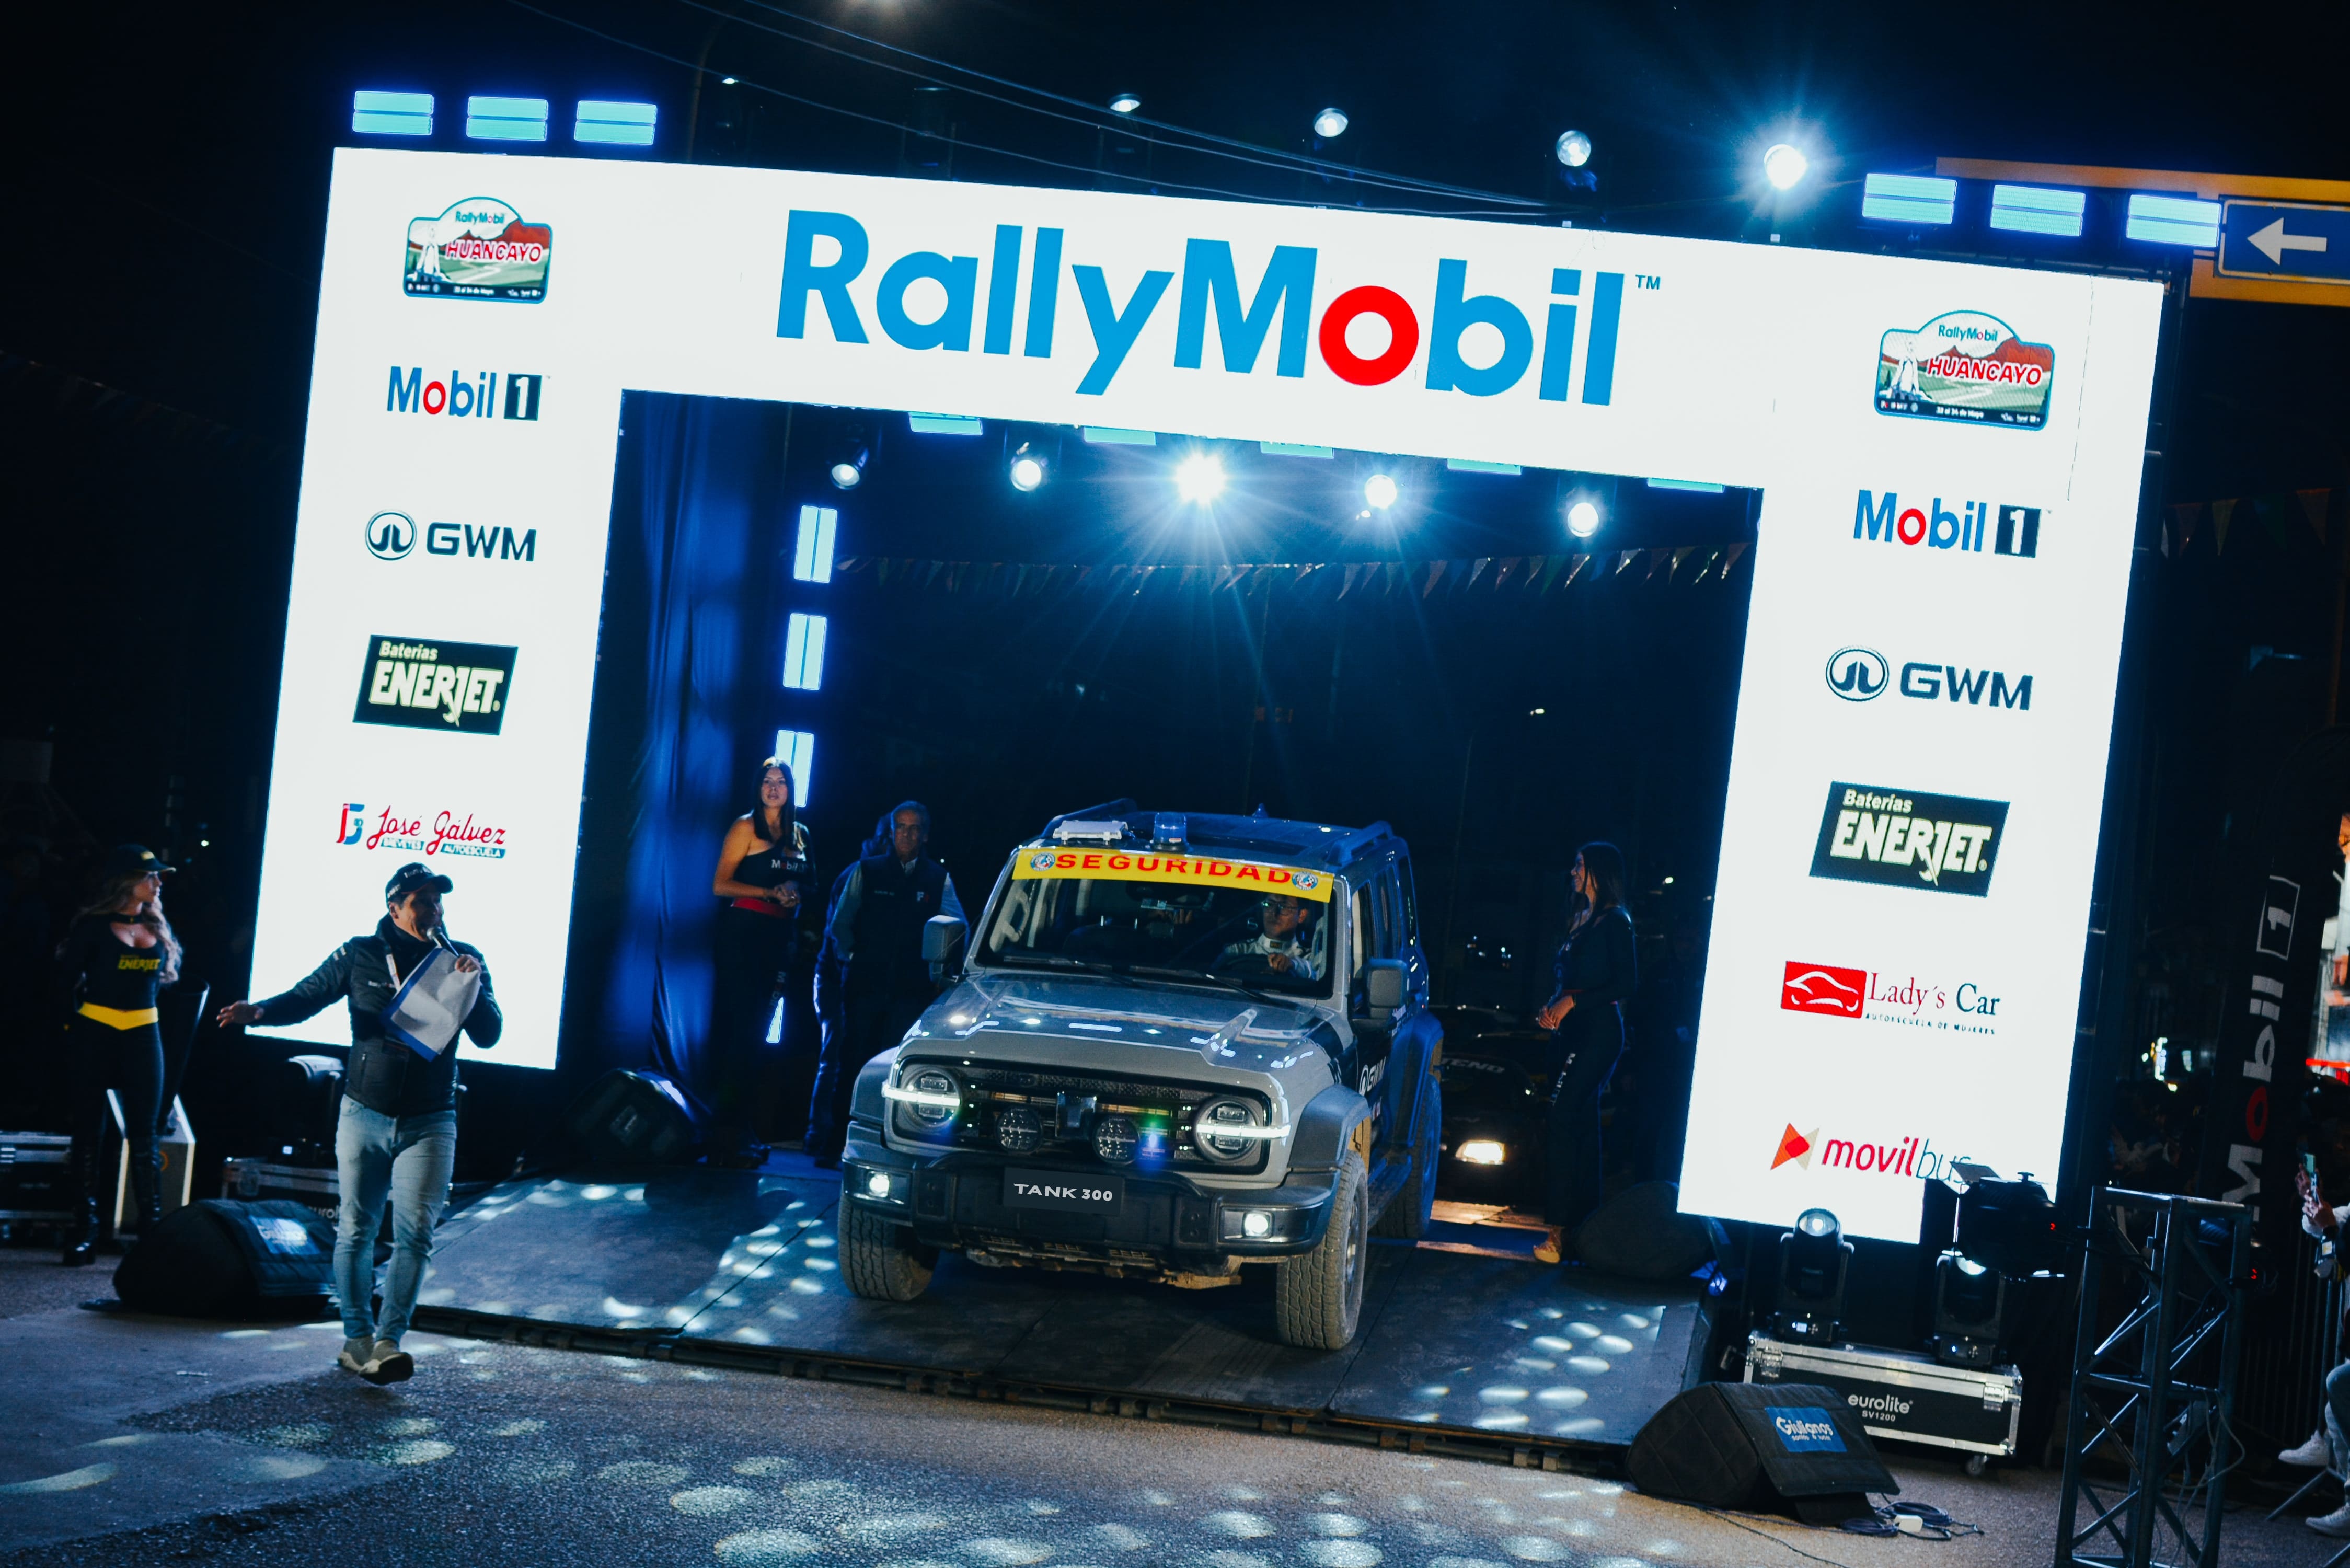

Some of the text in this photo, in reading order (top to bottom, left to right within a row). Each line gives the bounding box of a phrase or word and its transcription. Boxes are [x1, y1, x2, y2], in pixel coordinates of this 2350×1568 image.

[446, 239, 542, 263] HUANCAYO
[777, 210, 1624, 405] RallyMobil
[1938, 325, 1998, 342] RallyMobil
[1927, 356, 2042, 386] HUANCAYO
[387, 366, 497, 418] Mobil
[1853, 489, 1987, 552] Mobil
[426, 522, 537, 562] GWM
[368, 660, 505, 727] ENERJET
[1899, 662, 2033, 711] GWM
[366, 805, 506, 856] José Gálvez
[1829, 810, 1993, 887] ENERJET
[1056, 854, 1292, 884] SEGURIDAD
[1956, 983, 2000, 1016] Car
[1013, 1183, 1113, 1202] TANK 300
[1848, 1394, 1910, 1414] eurolite
[1862, 1410, 1896, 1422] SV1200
